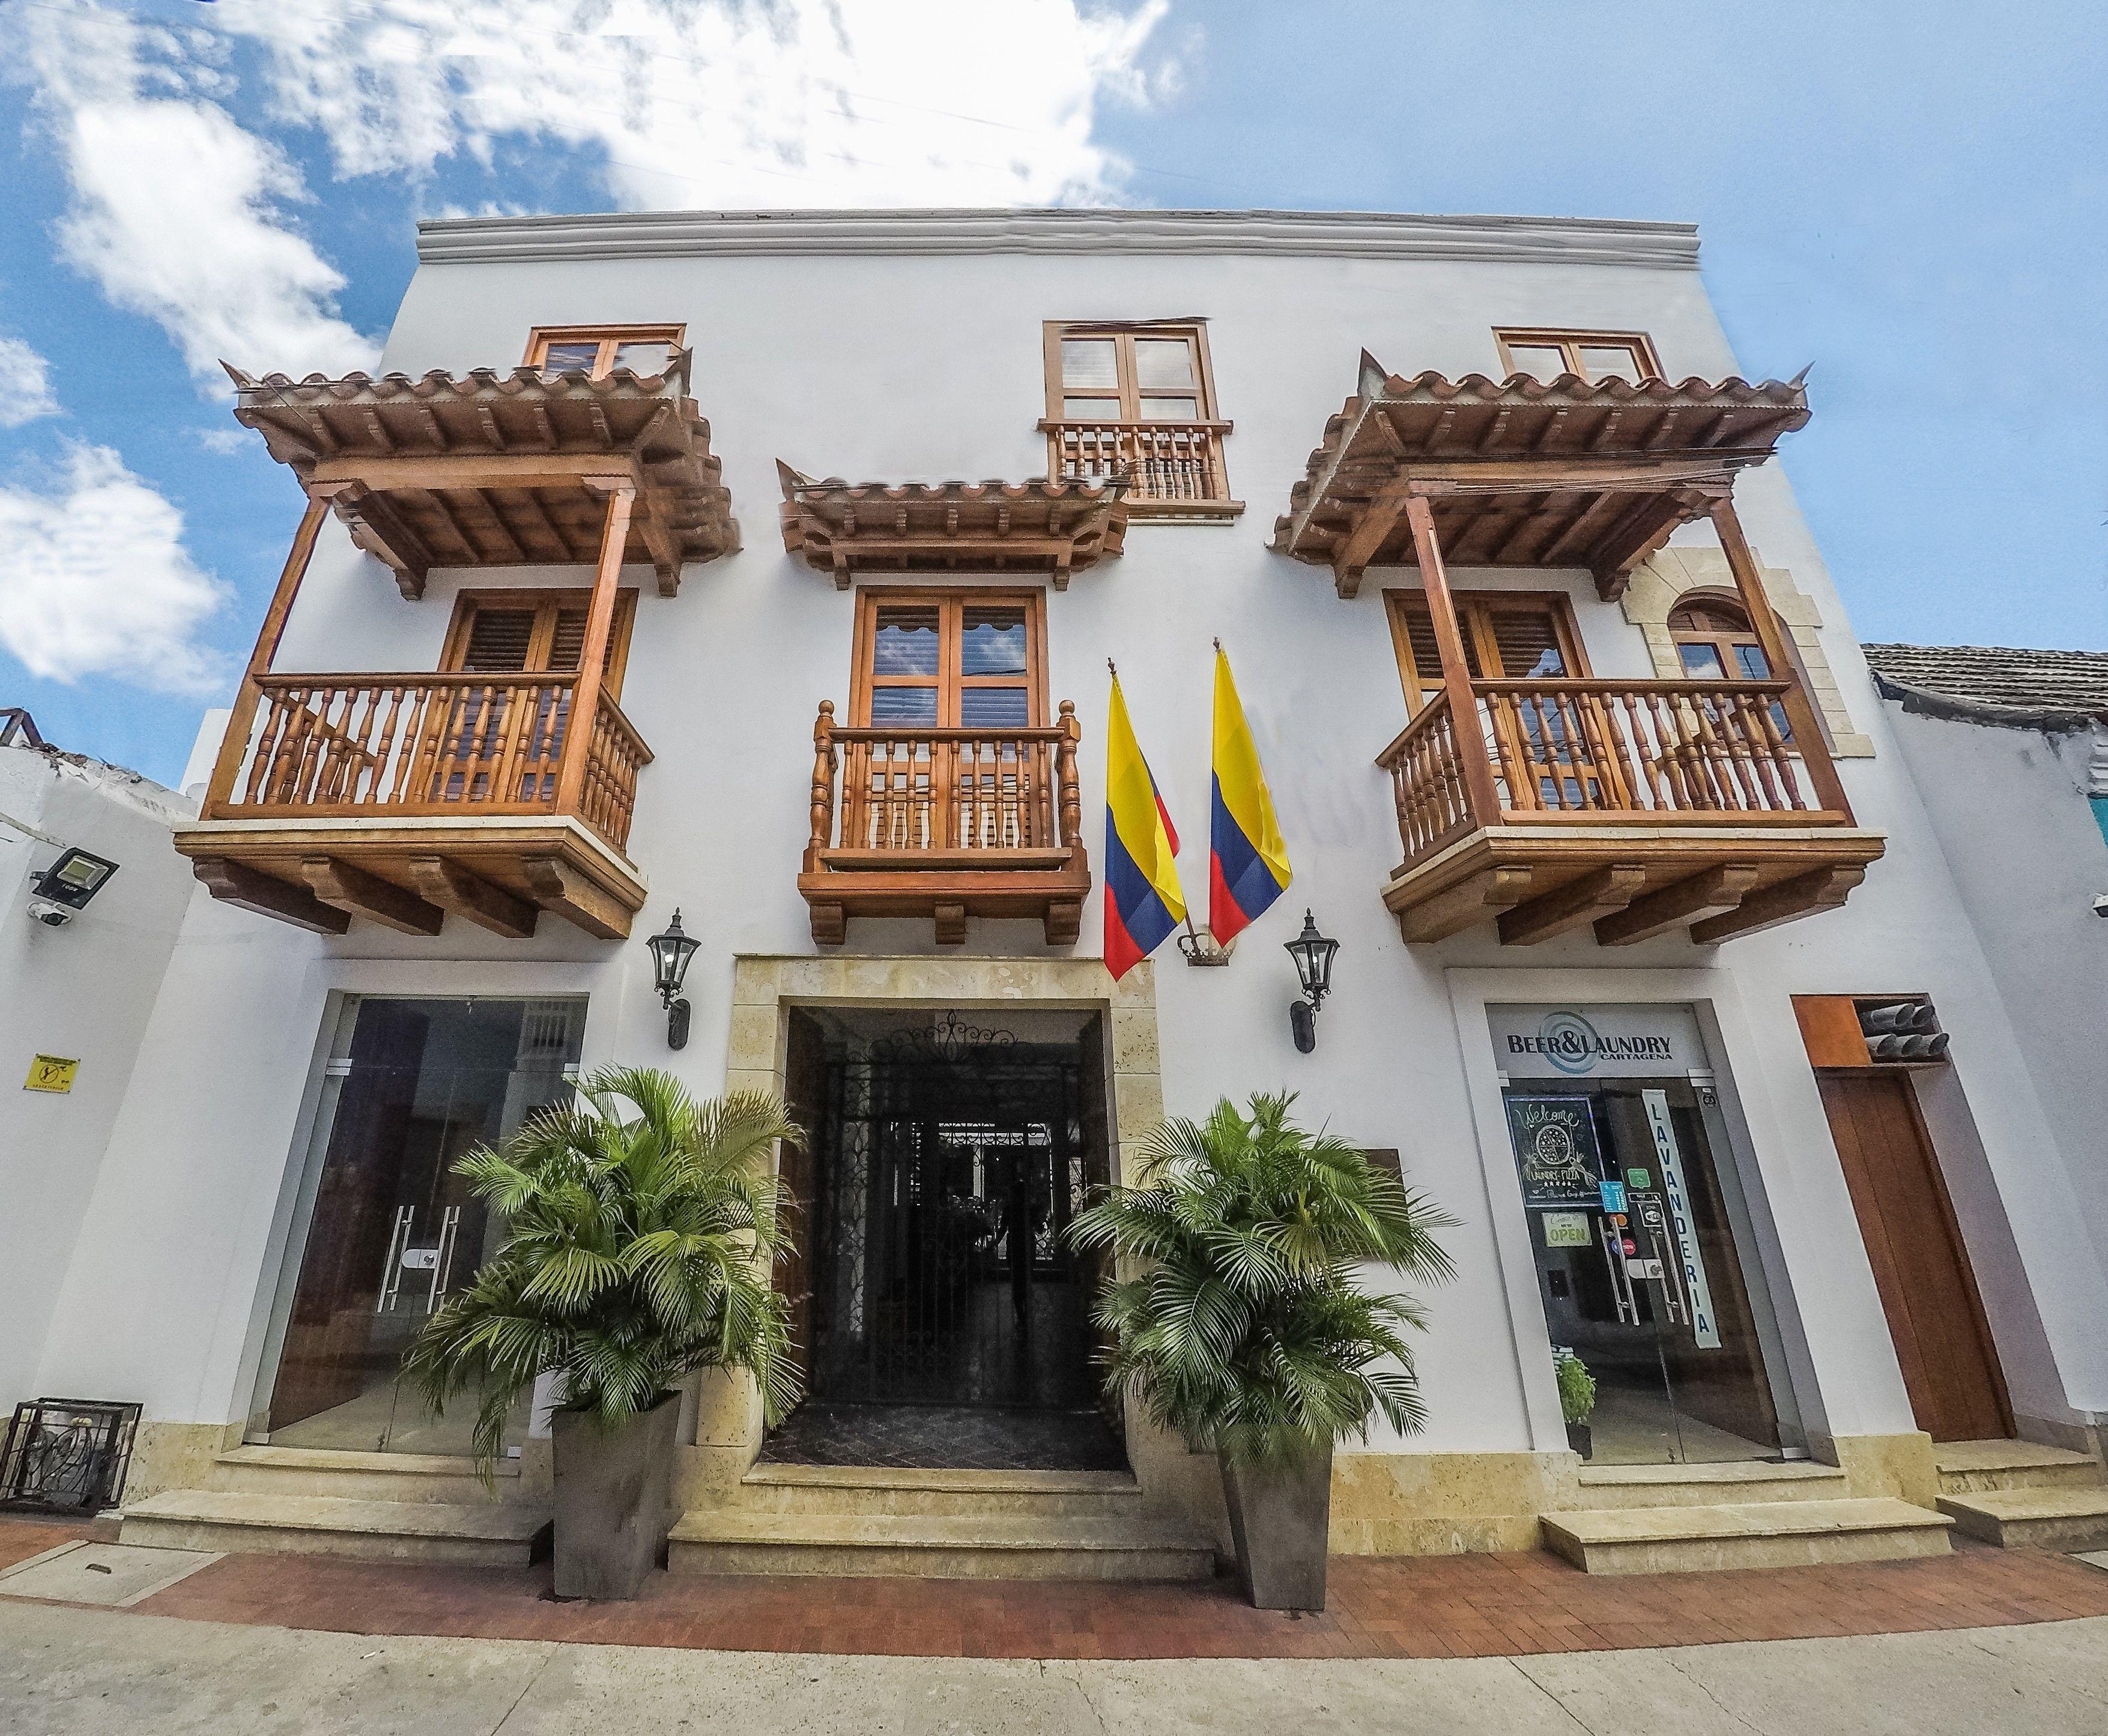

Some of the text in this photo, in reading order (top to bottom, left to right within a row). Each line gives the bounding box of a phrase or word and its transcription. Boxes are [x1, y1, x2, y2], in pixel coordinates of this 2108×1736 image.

[1515, 1104, 1579, 1128] Welcome
[1651, 1103, 1710, 1332] LAVANDERIA
[1550, 1229, 1585, 1242] OPEN
